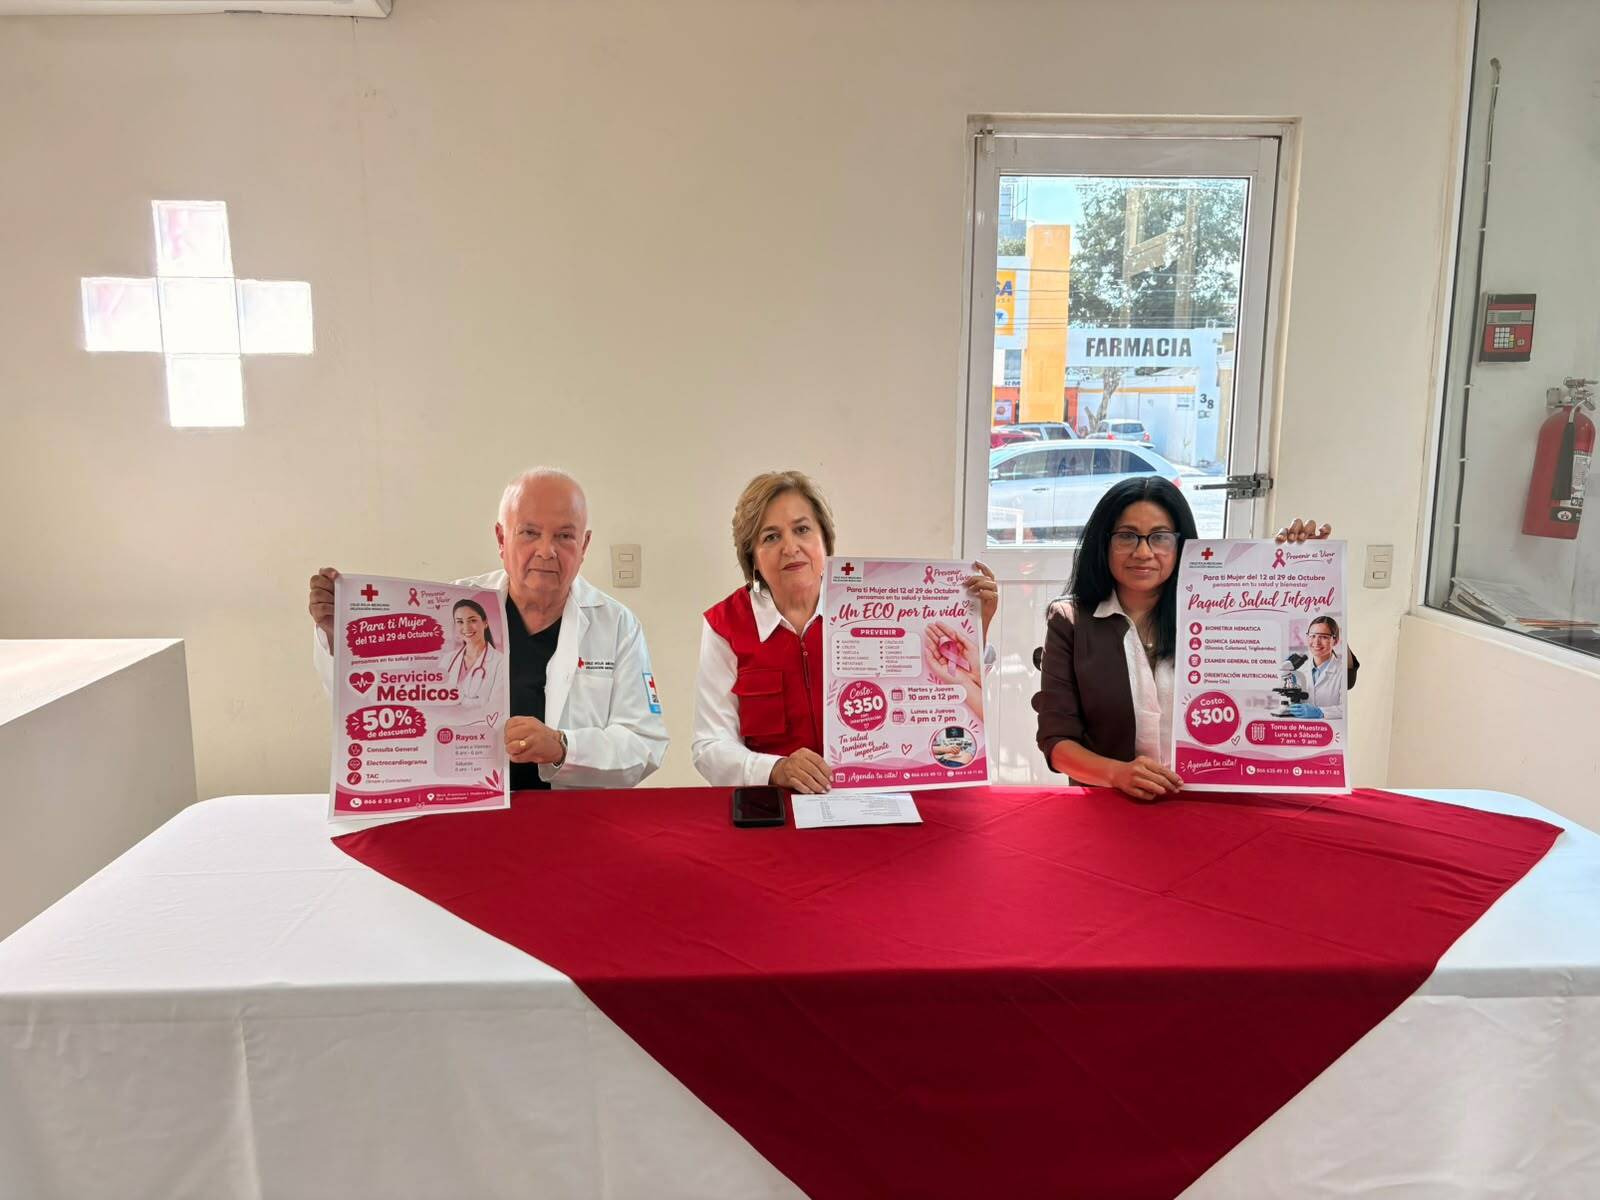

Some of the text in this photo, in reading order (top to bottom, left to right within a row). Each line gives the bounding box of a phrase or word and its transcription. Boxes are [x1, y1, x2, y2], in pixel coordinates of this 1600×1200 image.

[1086, 337, 1192, 357] FARMACIA
[1286, 552, 1310, 560] Prevenir
[934, 569, 961, 577] Prevenir
[869, 586, 887, 594] Mujer
[1188, 586, 1334, 613] Paquete Salud Integral
[839, 602, 967, 622] Un ECO por tu vida
[360, 617, 427, 633] Para ti Mujer
[355, 631, 433, 645] del 12 al 29 de Octubre
[380, 671, 443, 683] Servicios
[377, 684, 460, 701] Médicos
[850, 687, 873, 699] Costo:
[843, 695, 883, 717] $350
[1200, 698, 1225, 706] Costo:
[362, 708, 412, 731] 50%
[1191, 706, 1235, 727] $300
[378, 728, 417, 736] descuento
[456, 734, 478, 742] Rayos
[839, 732, 868, 744] Tu salud
[842, 742, 867, 753] también
[855, 742, 889, 758] importante
[1222, 758, 1237, 766] cita!
[848, 772, 875, 782] ¡Agenda
[884, 771, 898, 779] cita!
